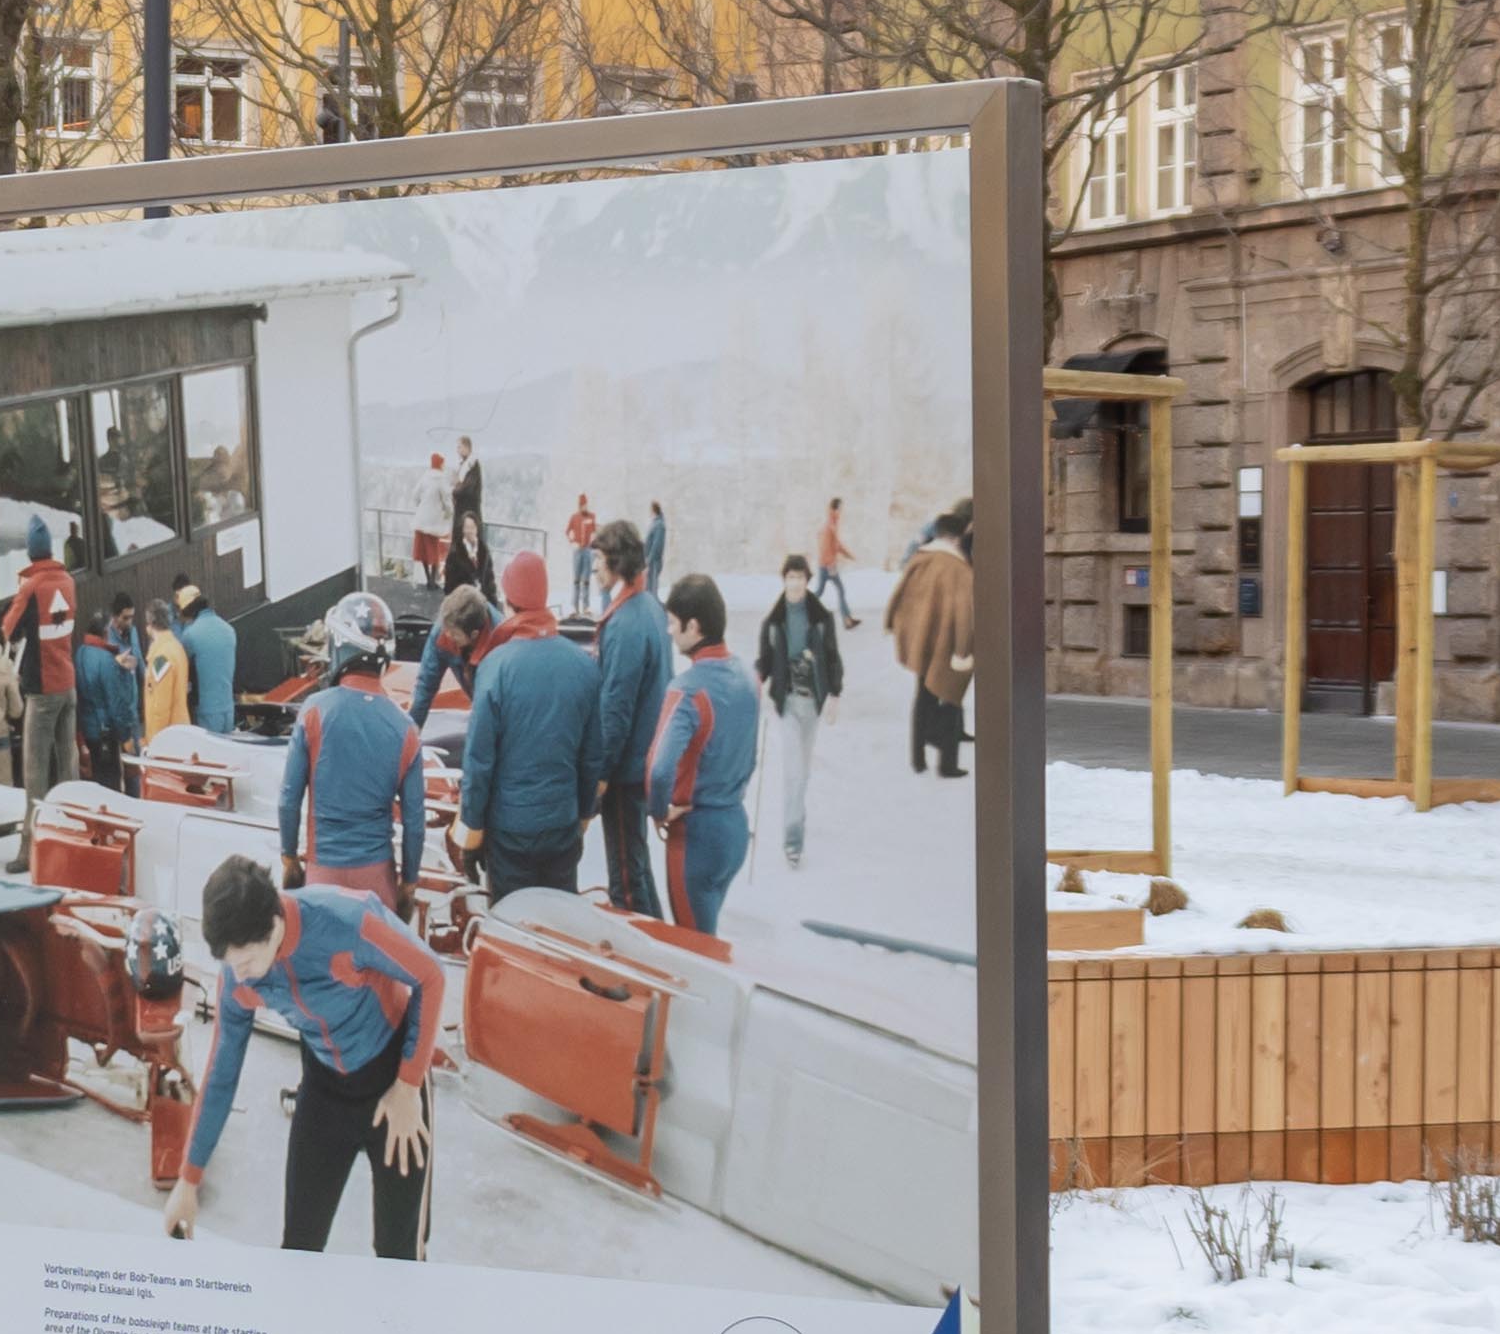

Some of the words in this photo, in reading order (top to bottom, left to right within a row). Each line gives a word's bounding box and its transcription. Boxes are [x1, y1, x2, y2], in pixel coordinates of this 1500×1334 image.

[44, 1263, 111, 1280] Vorbereitungen
[112, 1270, 127, 1281] der
[129, 1271, 176, 1286] Bob-Teams
[179, 1278, 193, 1287] am
[195, 1278, 253, 1293] Startbereich
[44, 1279, 59, 1289] des
[61, 1280, 96, 1294] Olympia
[99, 1283, 135, 1296] Eiskanal
[44, 1307, 99, 1323] Preparations
[101, 1313, 111, 1324] of
[112, 1315, 127, 1326] the
[128, 1316, 171, 1331] bobsleigh
[173, 1321, 200, 1333] teams
[202, 1324, 212, 1334] at
[44, 1324, 63, 1334] area
[65, 1324, 75, 1334] of
